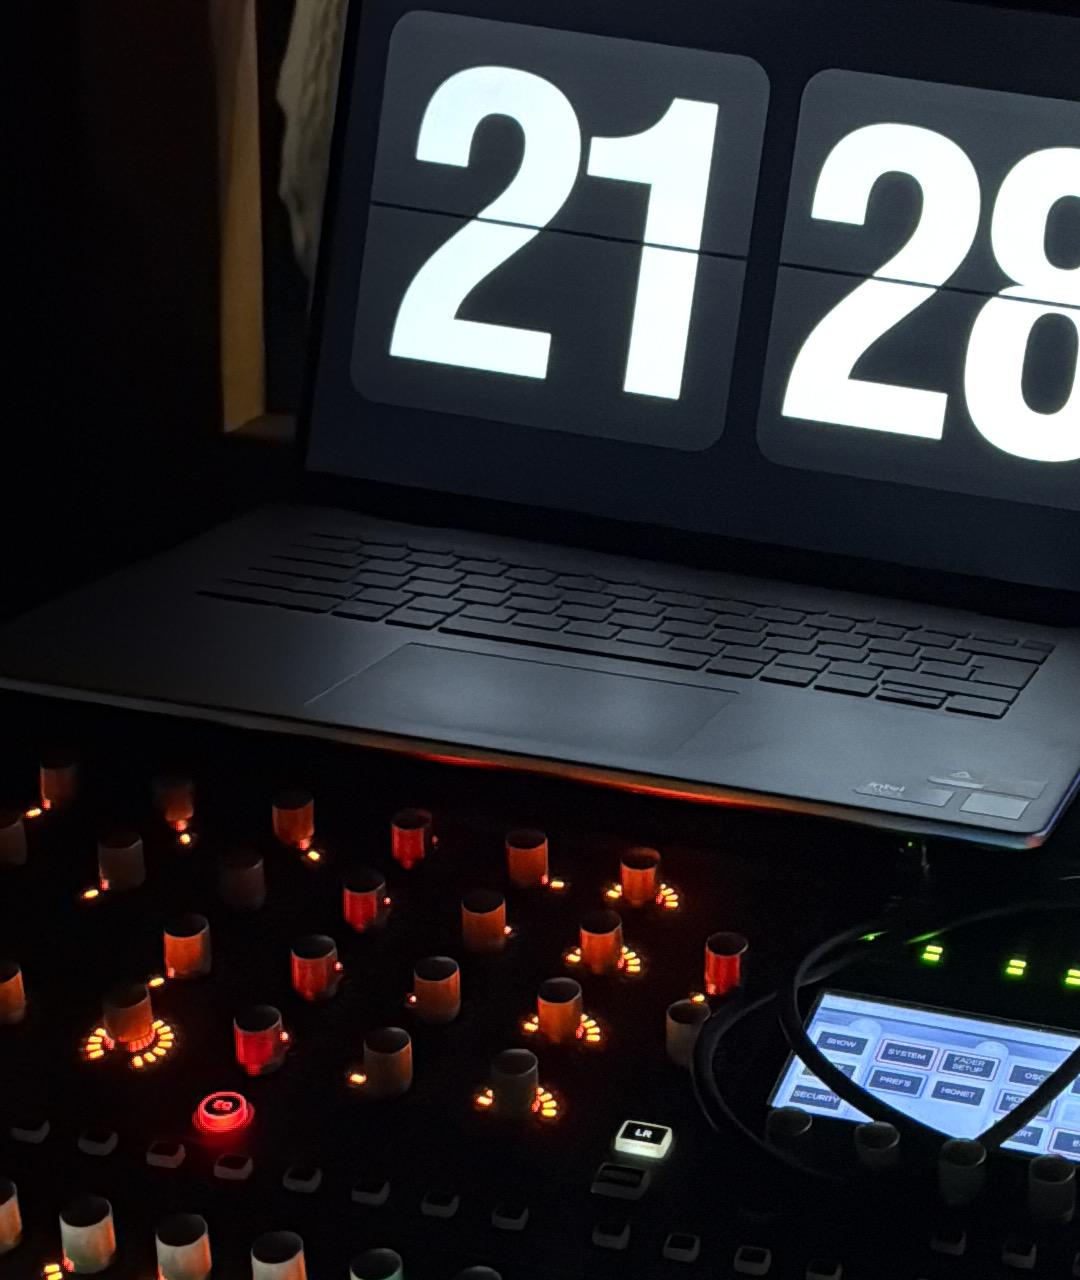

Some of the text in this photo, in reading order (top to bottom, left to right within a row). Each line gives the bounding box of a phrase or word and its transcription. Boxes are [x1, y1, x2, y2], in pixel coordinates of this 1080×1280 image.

[389, 65, 719, 401] 21
[887, 1047, 926, 1060] SYSTEM
[952, 1063, 983, 1073] SETUP
[793, 1090, 840, 1103] SECURITY
